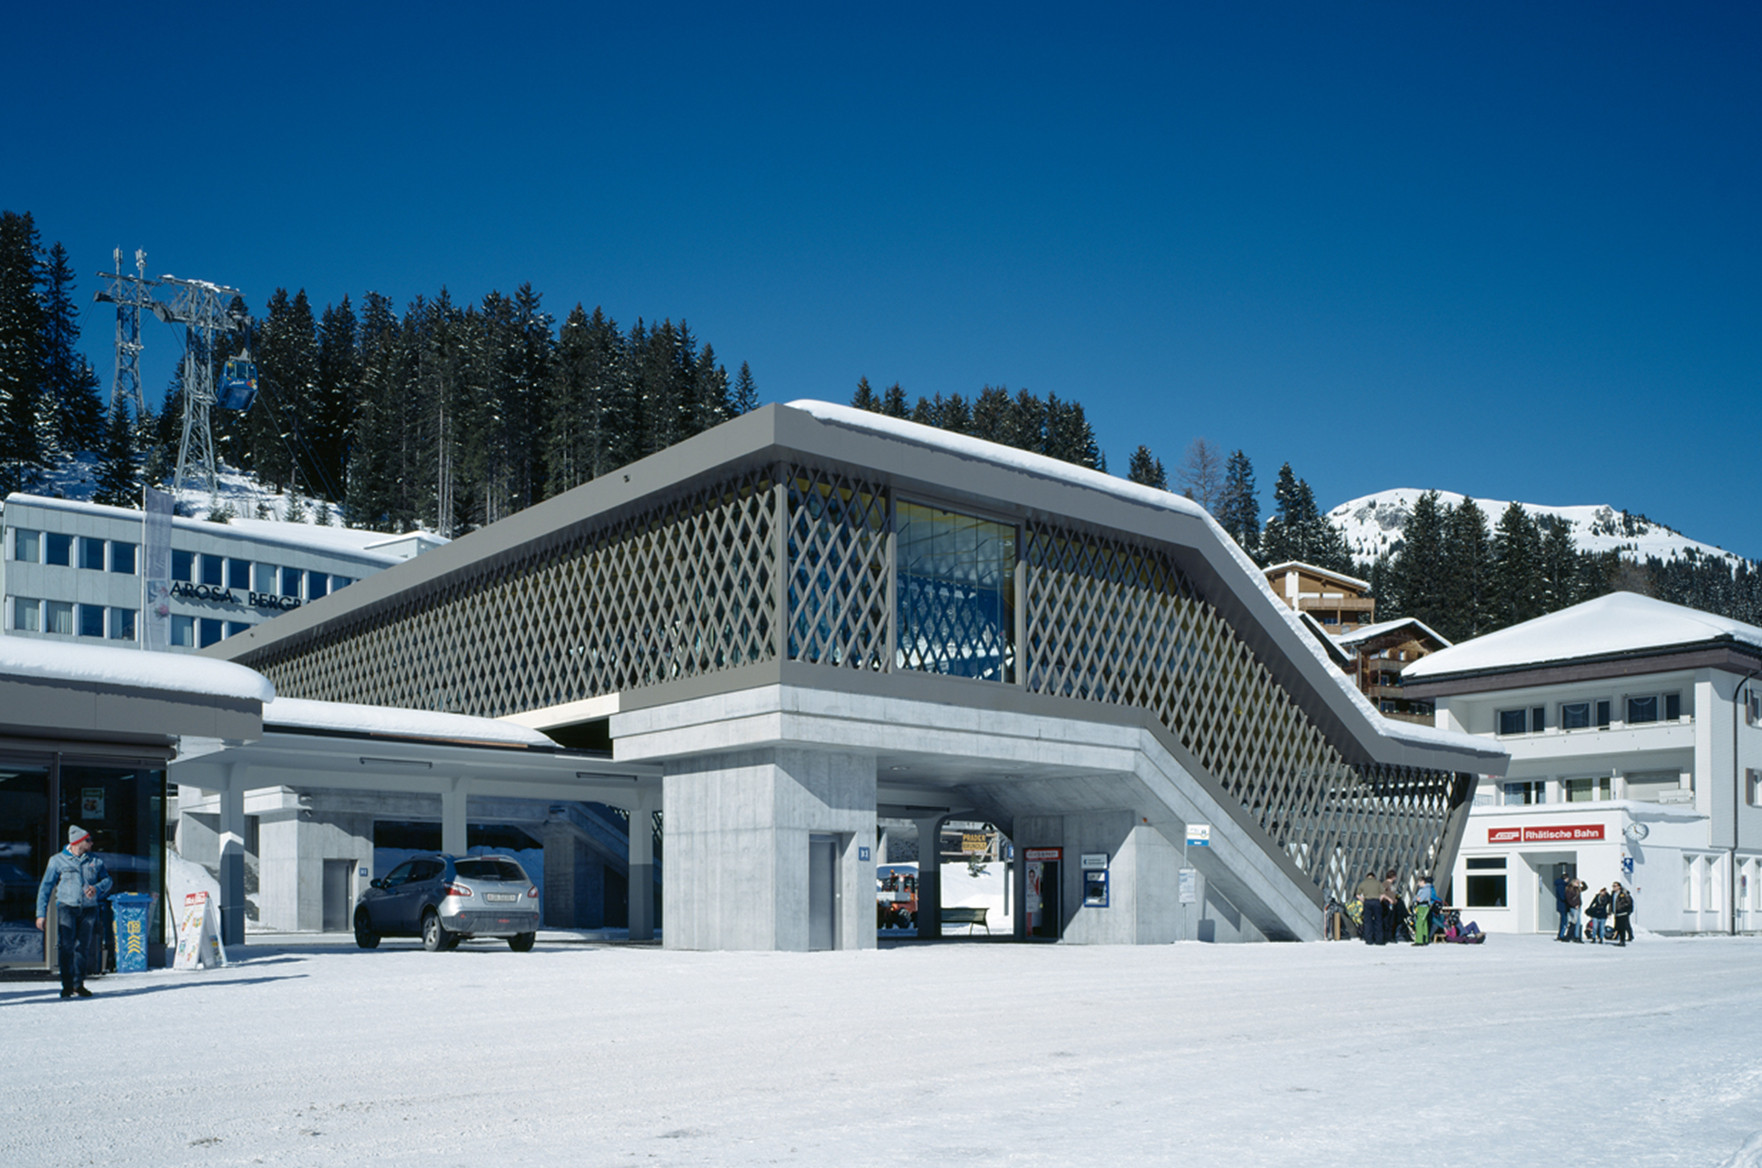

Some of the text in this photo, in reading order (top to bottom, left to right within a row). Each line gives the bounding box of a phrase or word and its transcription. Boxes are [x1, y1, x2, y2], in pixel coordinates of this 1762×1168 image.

[170, 580, 233, 603] AROSA
[1525, 829, 1571, 840] Rhätische
[1573, 828, 1599, 838] Bahn
